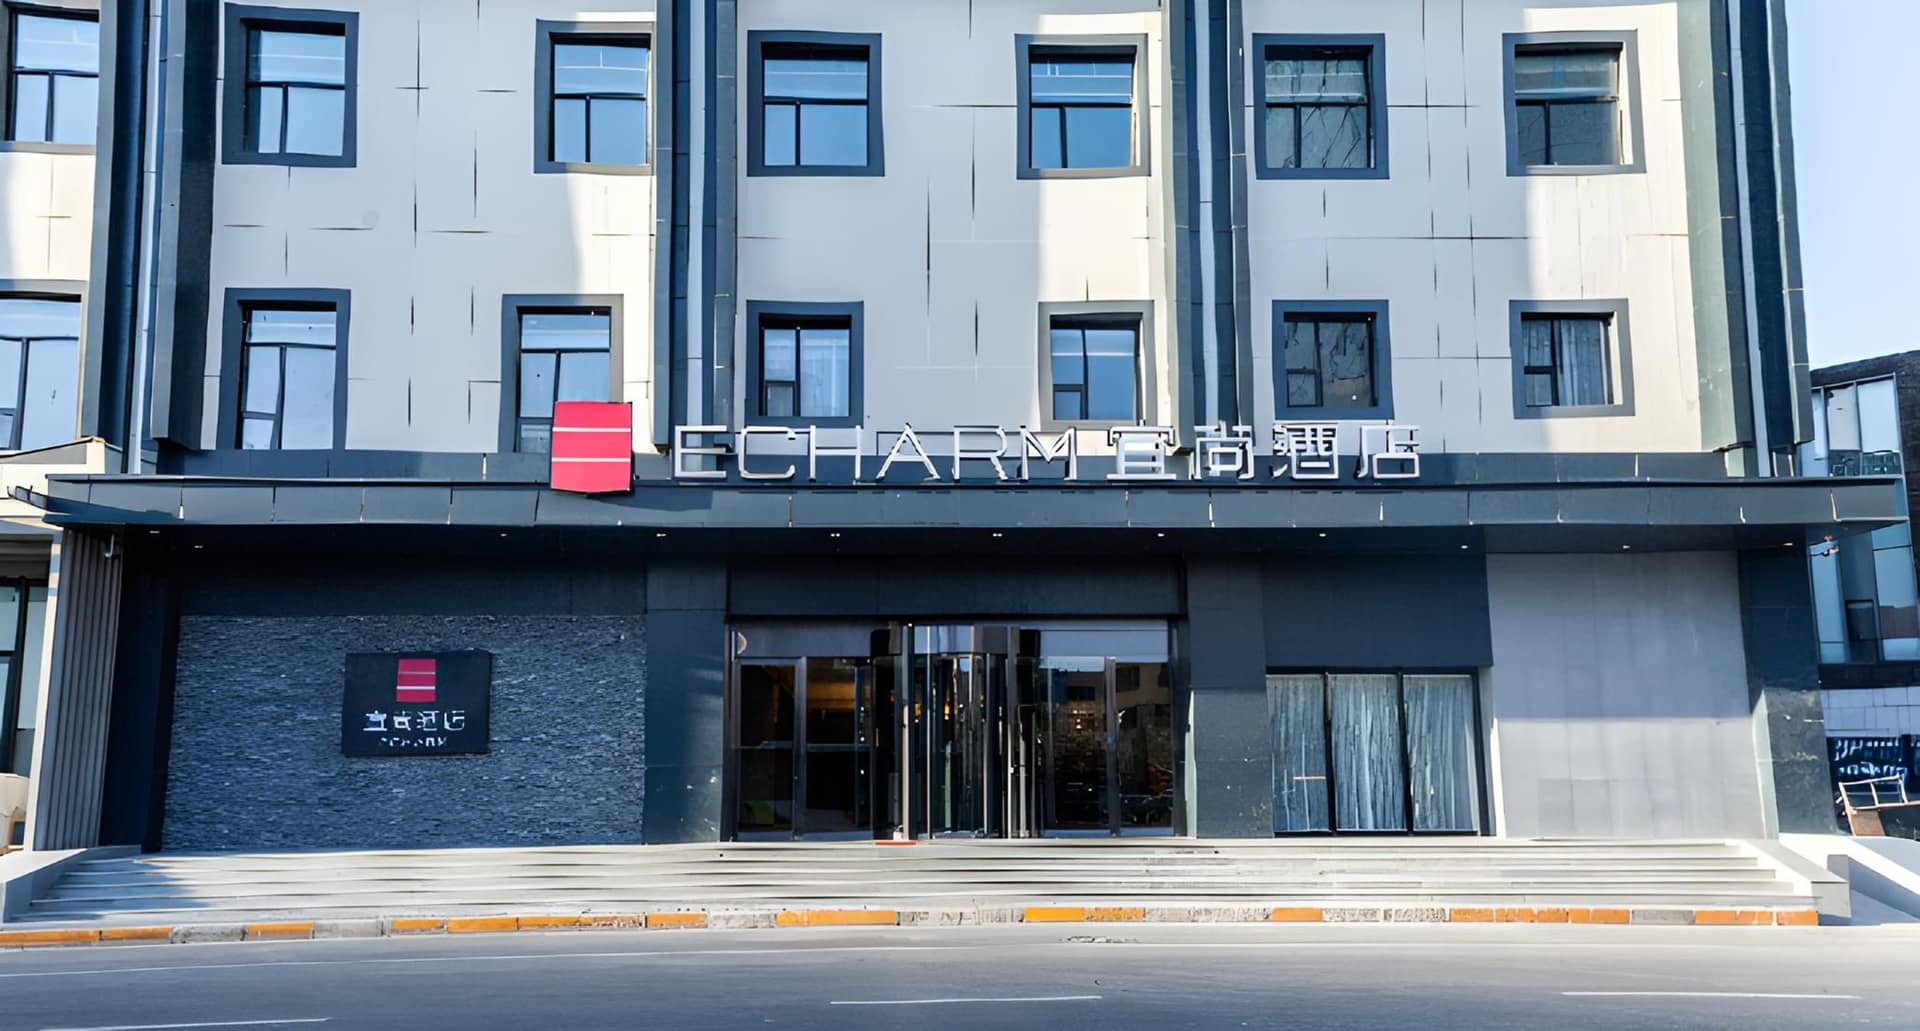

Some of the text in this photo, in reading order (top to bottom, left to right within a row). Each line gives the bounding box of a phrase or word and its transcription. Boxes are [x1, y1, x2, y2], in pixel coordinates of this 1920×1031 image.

[675, 421, 1420, 481] ECHARM 宜尚酒店
